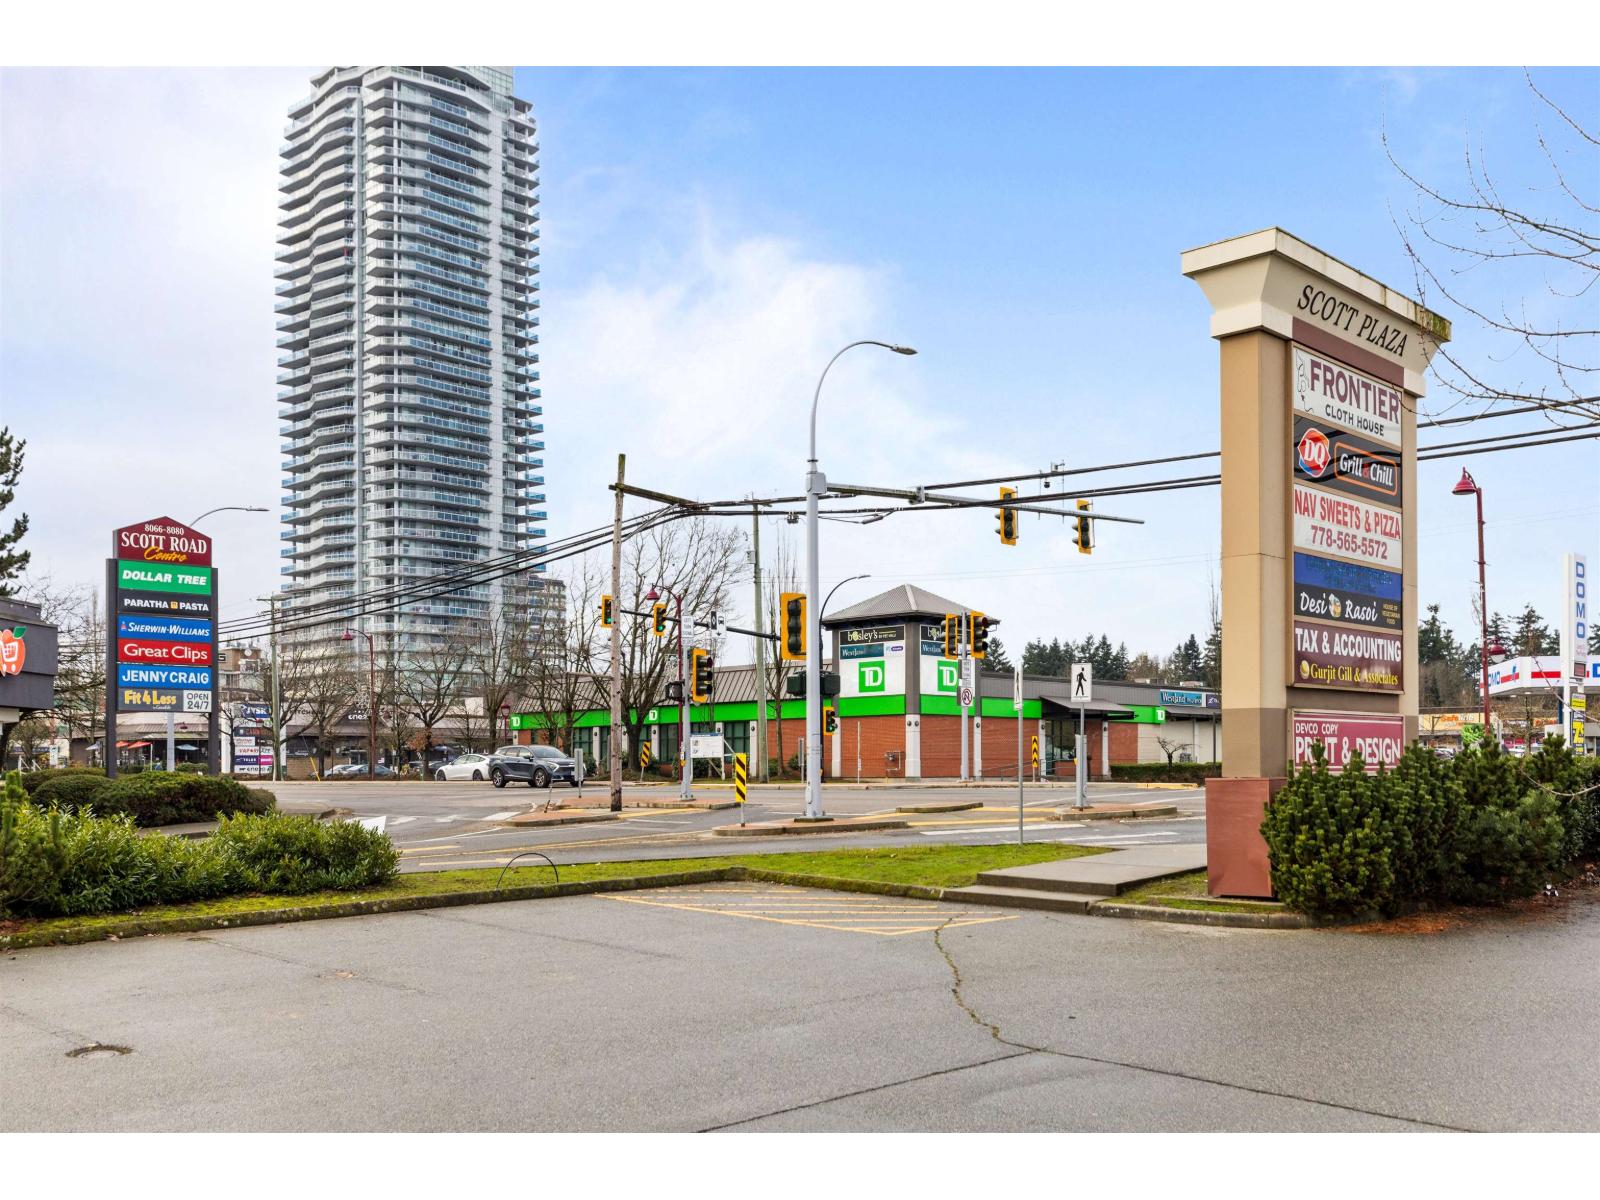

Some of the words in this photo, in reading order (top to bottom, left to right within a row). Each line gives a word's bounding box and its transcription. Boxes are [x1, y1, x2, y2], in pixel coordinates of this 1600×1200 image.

[1297, 284, 1359, 331] SCOTT
[1357, 314, 1408, 357] PLAZA
[1310, 358, 1399, 424] FRONTIER
[1325, 403, 1354, 426] CLOTH
[1357, 416, 1385, 437] HOUSE
[1304, 438, 1325, 468] DQ
[1339, 453, 1362, 477] Grill
[1362, 466, 1370, 478] &
[1370, 463, 1394, 486] Chill
[1294, 489, 1317, 518] NAV
[1320, 496, 1361, 530] SWEETS
[1364, 509, 1372, 533] &
[1374, 511, 1401, 540] PIZZA
[144, 523, 185, 536] 8066-8080
[121, 531, 166, 550] SCOTT
[170, 536, 207, 554] ROAD
[1311, 525, 1388, 560] 778-565-5572
[143, 546, 188, 562] Centre
[122, 570, 172, 583] DOLLAR
[177, 574, 207, 586] TREE
[124, 598, 169, 609] PARATHA
[179, 602, 209, 611] PASTA
[1300, 591, 1328, 615] Desi
[1345, 600, 1377, 622] Rasoi
[1576, 562, 1585, 639] DOMO
[123, 643, 169, 657] Great
[171, 646, 208, 662] Clips
[1295, 627, 1318, 653] TAX
[1322, 631, 1330, 654] &
[1333, 633, 1402, 662] ACCOUNTING
[122, 669, 168, 682] JENNY
[169, 671, 209, 684] CRAIG
[860, 666, 883, 686] TD
[939, 666, 957, 687] TD
[1310, 663, 1336, 684] Gurjit
[1338, 665, 1353, 681] Gill
[1354, 668, 1361, 683] &
[1362, 668, 1399, 685] Associates
[124, 689, 142, 704] Fit
[142, 689, 151, 703] 4
[152, 690, 177, 705] Less
[186, 692, 209, 701] OPEN
[187, 700, 209, 710] 24/7
[1296, 722, 1318, 734] DEVCO
[1322, 723, 1338, 735] COPY
[1341, 736, 1352, 763] &
[1356, 737, 1400, 763] DESIGN
